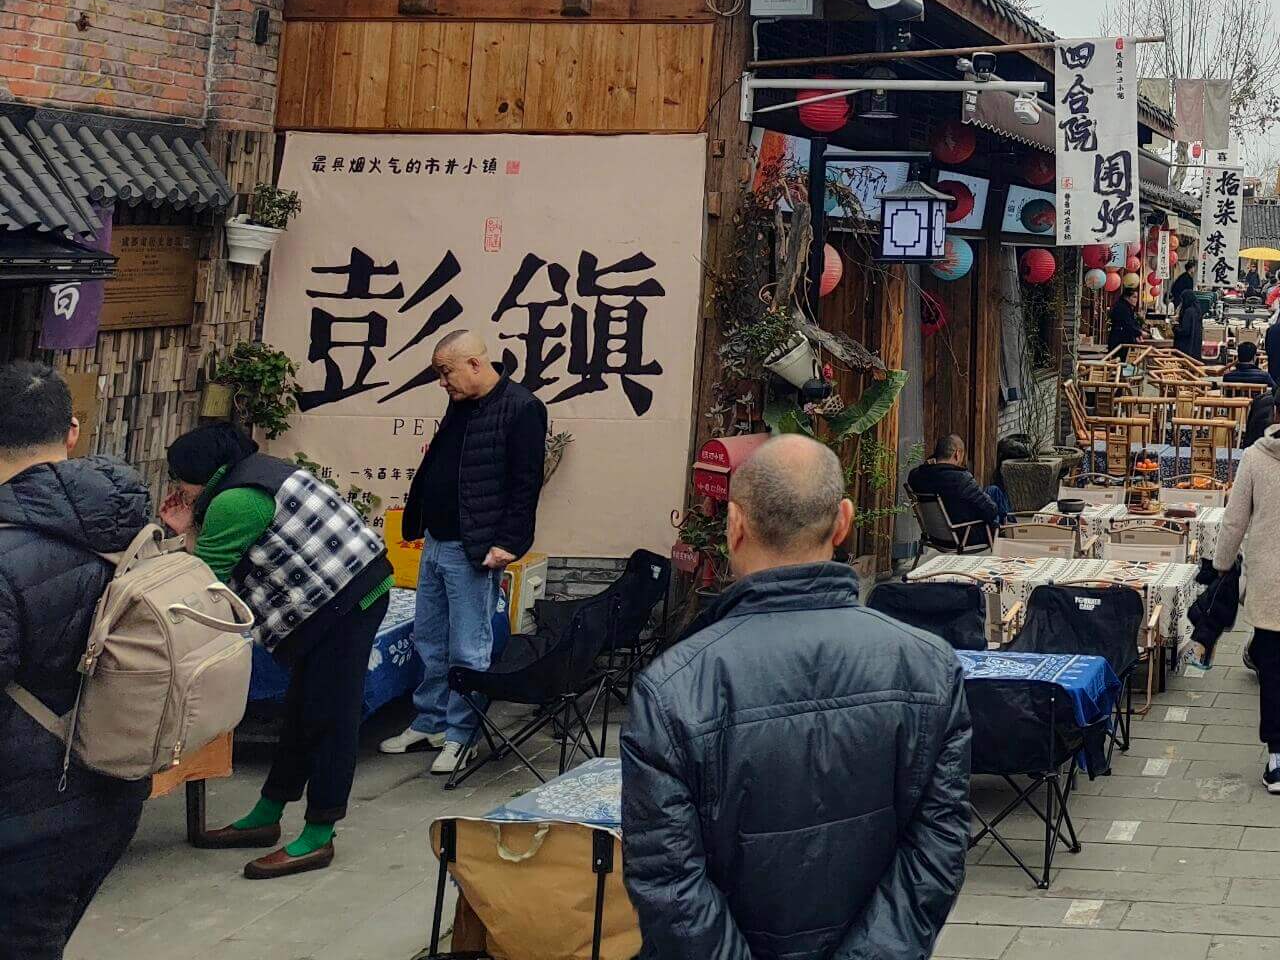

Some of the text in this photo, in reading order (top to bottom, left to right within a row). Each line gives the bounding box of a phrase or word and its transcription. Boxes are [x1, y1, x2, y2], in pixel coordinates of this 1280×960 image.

[1058, 42, 1098, 152] 四合院
[311, 155, 498, 175] 最具烟火气的市井小镇
[1091, 150, 1135, 242] 围炉
